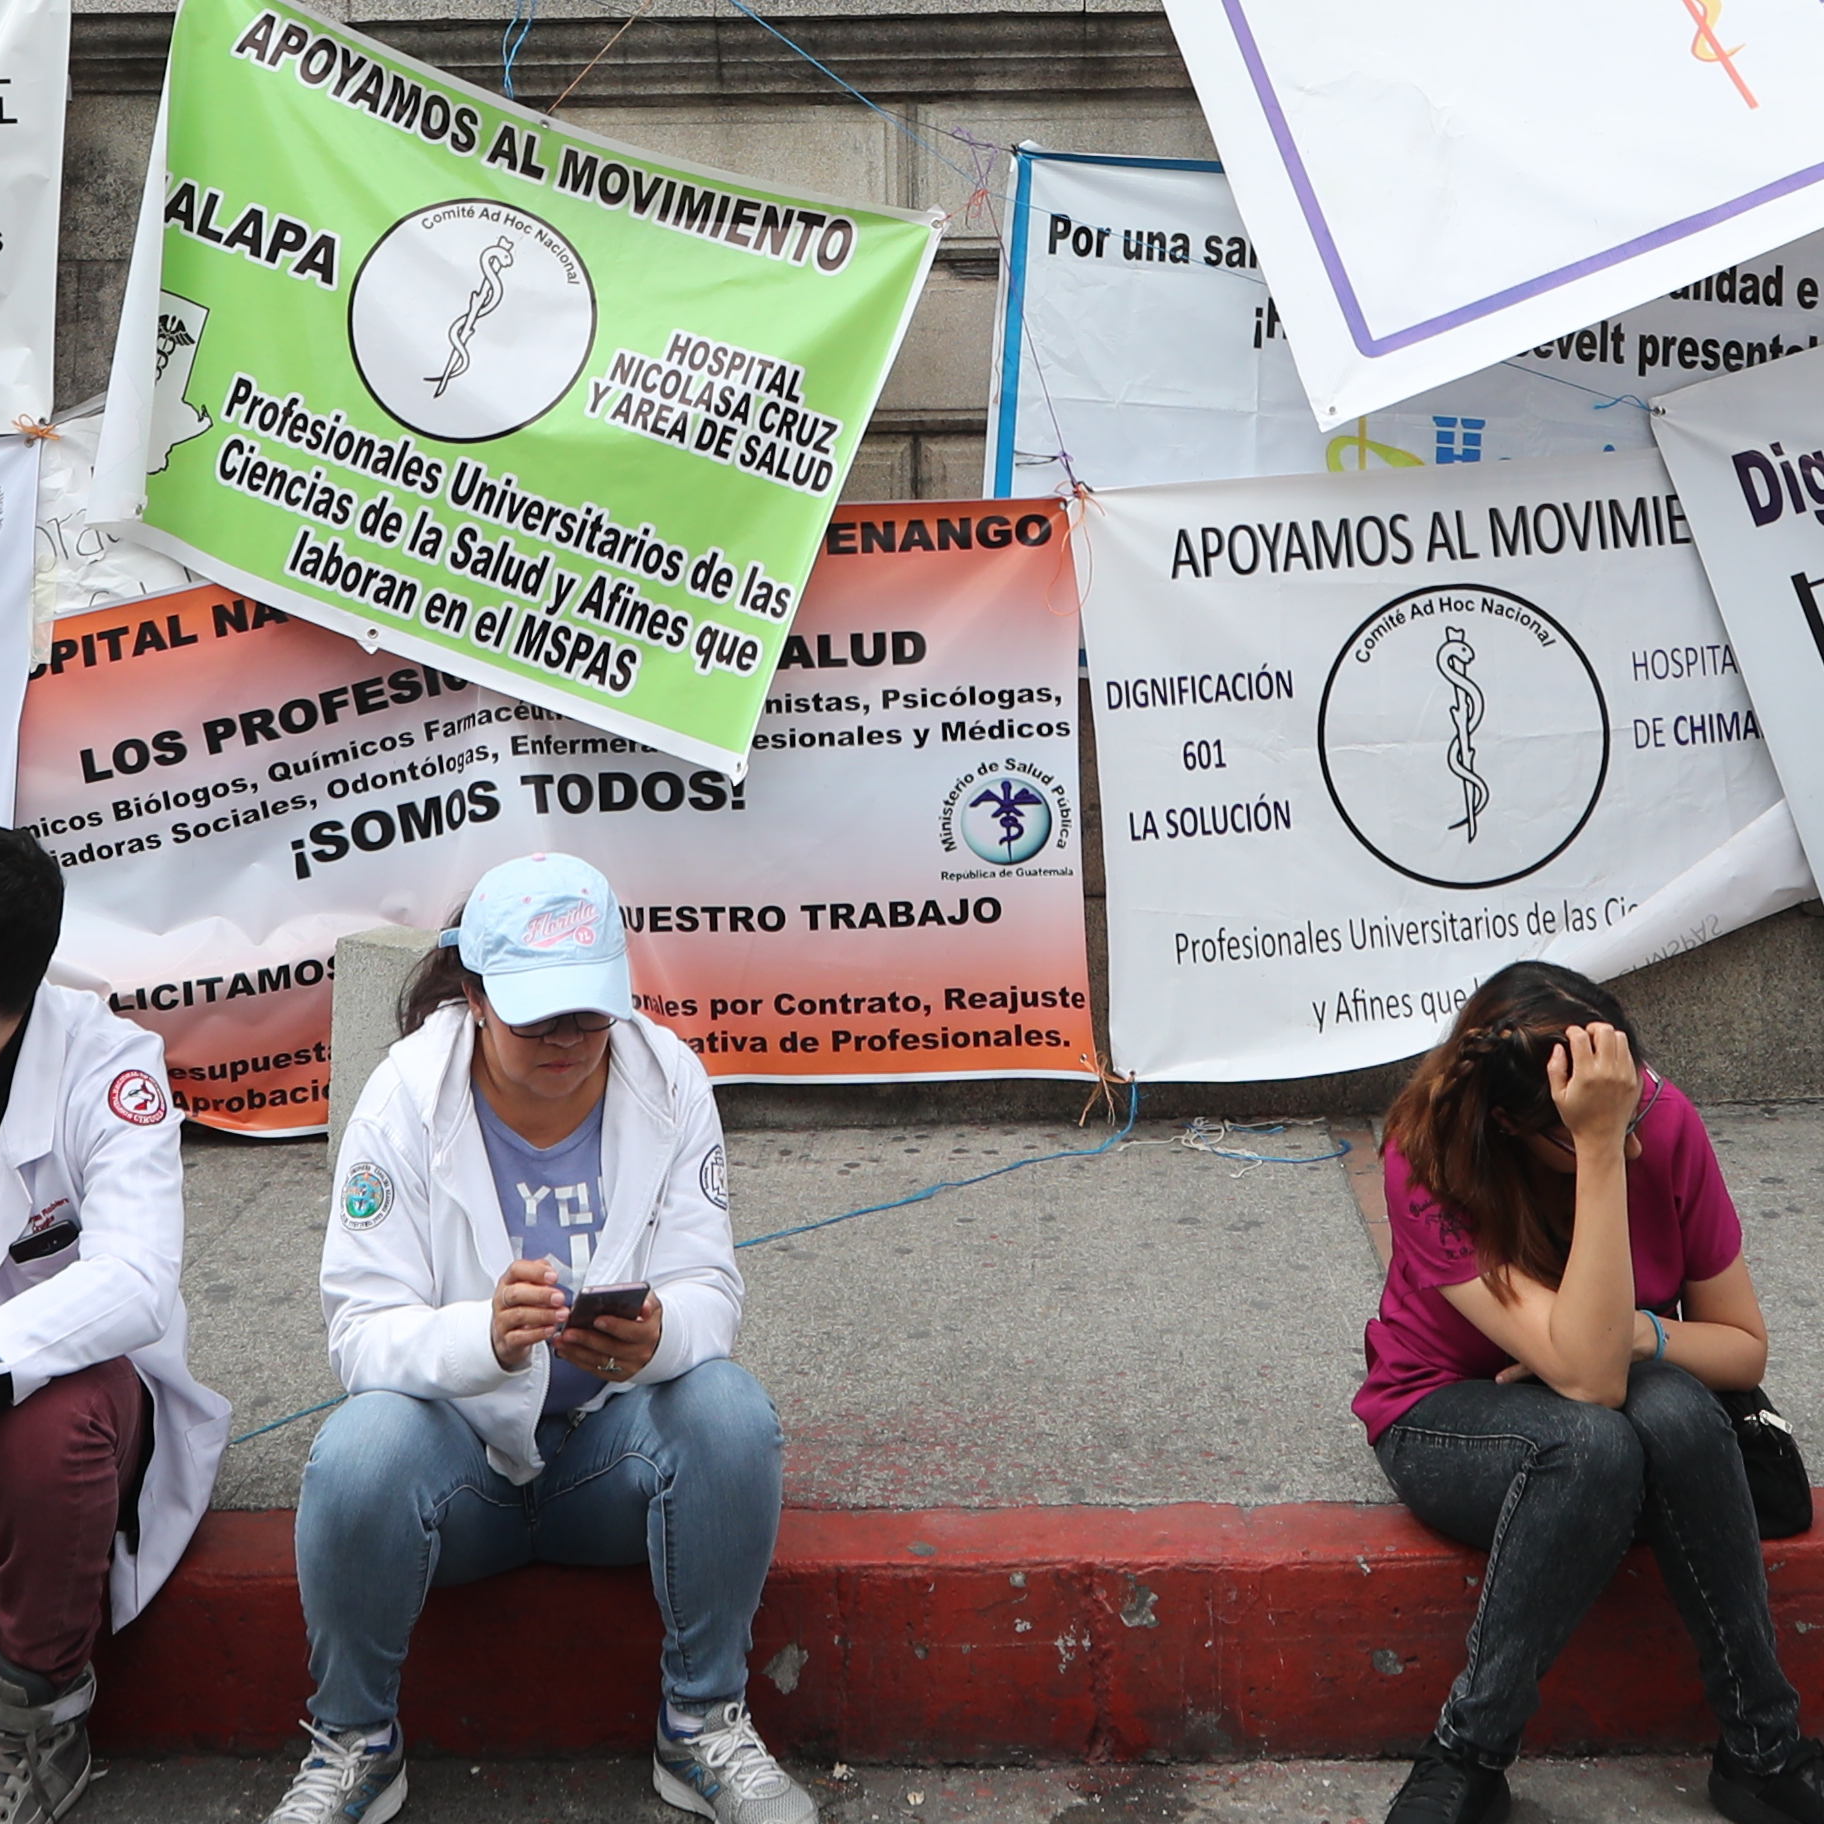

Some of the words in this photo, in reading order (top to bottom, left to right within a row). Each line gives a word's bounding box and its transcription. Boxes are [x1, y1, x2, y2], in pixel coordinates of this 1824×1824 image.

[234, 13, 479, 156] APOYAMOS
[486, 125, 547, 182] AL
[557, 148, 857, 273] MOVIMIENTO
[421, 206, 475, 230] Comité
[478, 208, 501, 222] Ad
[503, 213, 533, 235] Hoc
[534, 229, 580, 285] Nacional
[1047, 212, 1113, 258] Por
[1120, 222, 1191, 267] una
[1795, 273, 1821, 310] e
[609, 351, 754, 424] NICOLASA
[758, 398, 841, 456] CRUZ
[665, 330, 805, 405] HOSPITAL
[584, 378, 610, 415] Y
[608, 390, 691, 447] AREA
[693, 415, 735, 463] DE
[738, 433, 837, 495] SALUD
[222, 376, 443, 497] Profesionales
[447, 456, 686, 584] Universitarios
[689, 545, 738, 599] de
[740, 560, 795, 623] las
[217, 436, 373, 525] Ciencias
[357, 493, 404, 545] de
[408, 502, 447, 558] la
[447, 530, 552, 598] Salud
[545, 574, 573, 615] y
[577, 581, 689, 651] Afines
[695, 621, 761, 677] que
[1170, 512, 1416, 581] APOYAMOS
[1427, 506, 1481, 562] AL
[287, 531, 419, 621] laboran
[423, 589, 471, 637] en
[473, 600, 512, 651] el
[513, 613, 640, 694] MSPAS
[1355, 609, 1407, 664] Comité
[1410, 599, 1435, 620] Ad
[1439, 596, 1476, 613] Hoc
[1481, 597, 1556, 648] Nacional
[1106, 667, 1294, 711] DIGNIFICACIÓN
[80, 730, 188, 785] LOS
[113, 772, 260, 822] Biólogos,
[267, 730, 417, 783] Químicos
[880, 684, 1064, 711] Psicólogas,
[1182, 738, 1227, 773] 601
[1633, 717, 1667, 750] DE
[171, 793, 319, 847] Sociales,
[326, 745, 501, 801] Odontólogas,
[912, 725, 929, 750] y
[940, 715, 1073, 744] Médicos
[938, 774, 974, 852] Ministerio
[977, 762, 999, 776] de
[1005, 758, 1054, 785] Salud
[1051, 785, 1072, 849] Pública
[289, 778, 503, 880] ¡SOMOS
[521, 768, 747, 816] TODOS!
[1128, 810, 1161, 842] LA
[1165, 797, 1293, 840] SOLUCIÓN
[941, 871, 996, 882] República
[999, 868, 1013, 878] de
[1016, 867, 1073, 876] Guatemala
[523, 900, 596, 943] Florida
[799, 897, 1003, 931] TRABAJO
[1174, 927, 1343, 966] Profesionales
[1347, 906, 1521, 954] Universitarios
[1525, 907, 1557, 943] de
[1562, 901, 1599, 937] las
[709, 994, 764, 1023] por
[774, 988, 932, 1018] Contrato,
[943, 984, 1088, 1015] Reajuste
[778, 1029, 821, 1053] de
[830, 1025, 1073, 1053] Profesionales.
[1311, 998, 1330, 1033] y
[1334, 985, 1414, 1027] Afines
